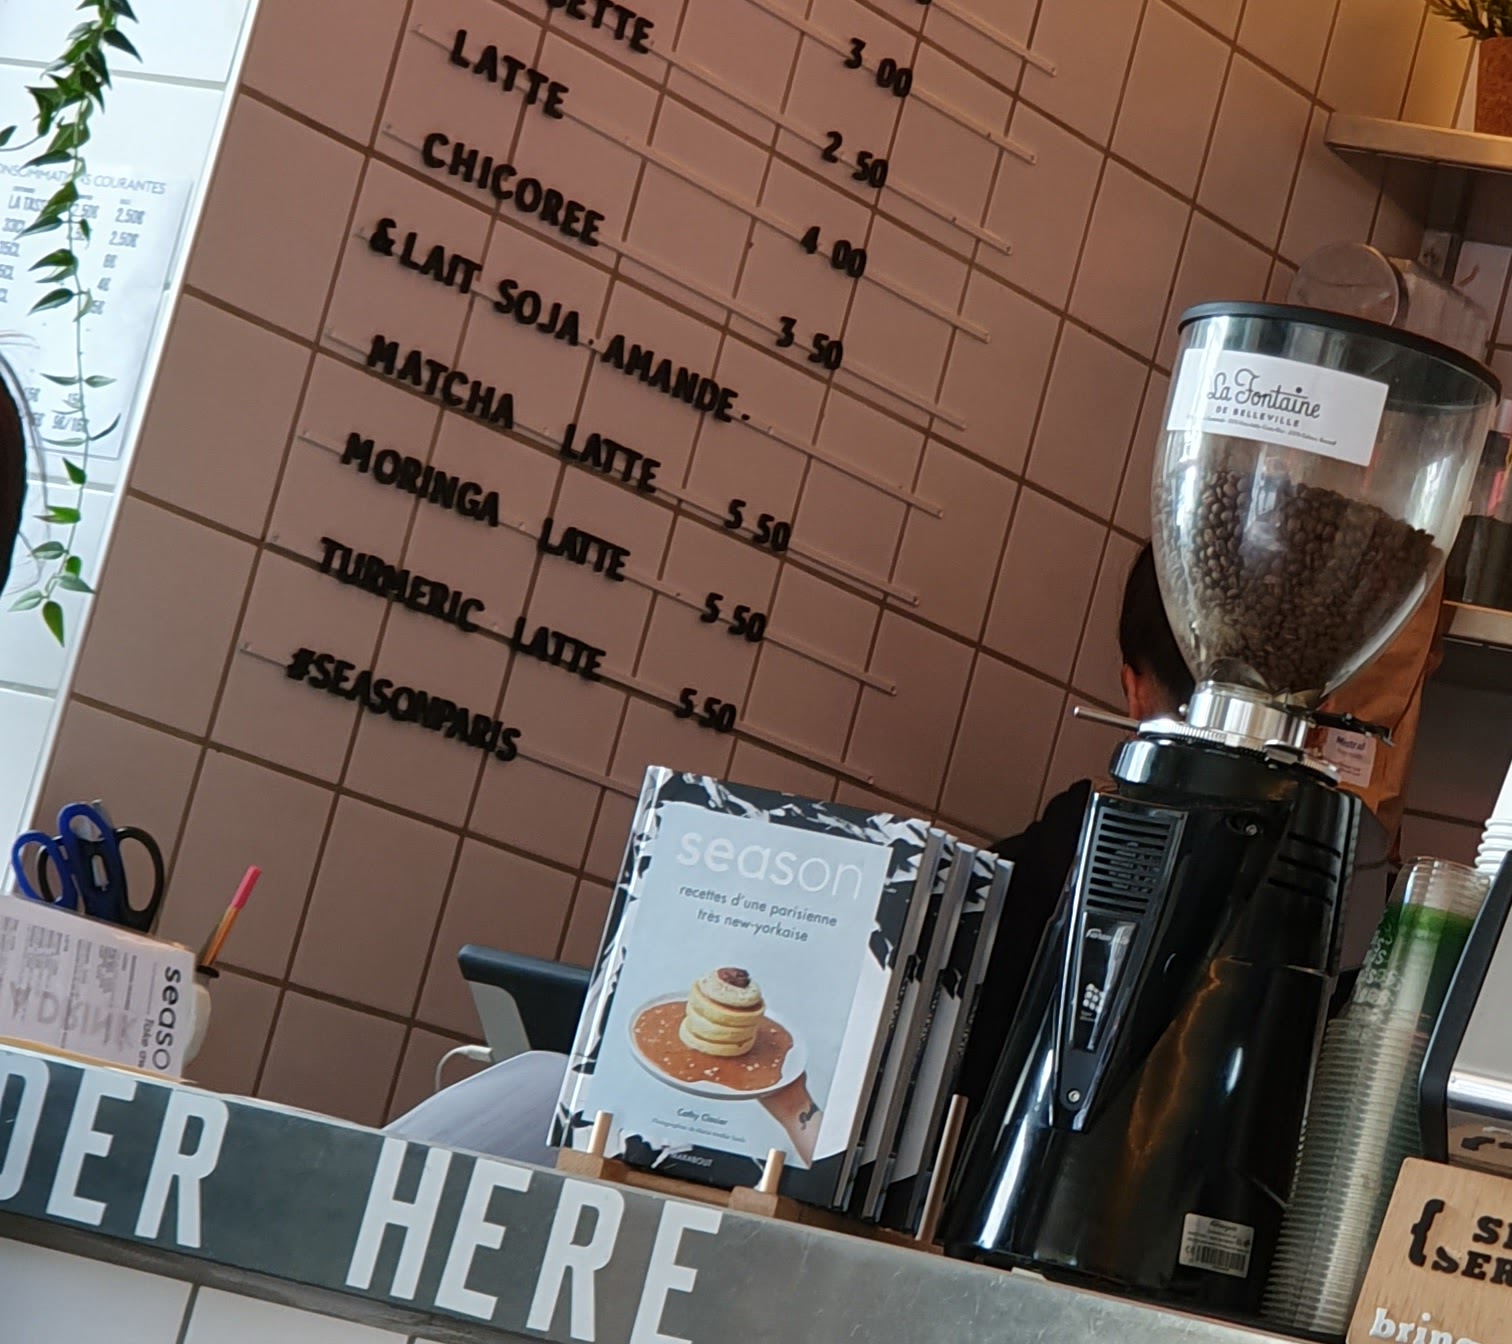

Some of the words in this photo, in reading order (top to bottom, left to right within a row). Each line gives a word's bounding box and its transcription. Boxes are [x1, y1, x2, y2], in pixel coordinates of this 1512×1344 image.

[450, 29, 569, 120] LATTE
[94, 175, 166, 195] COURANTES
[422, 133, 605, 247] CHICOREE
[367, 335, 514, 431] MATCHA
[559, 424, 661, 494] LATTE
[1207, 372, 1232, 401] La
[1235, 368, 1320, 419] Fontaine
[1233, 407, 1300, 427] BELLEVILLE
[341, 432, 500, 528] MORINGA
[539, 519, 630, 582] LATTE
[318, 538, 485, 634] TURMERIC
[512, 618, 606, 682] LATTE
[677, 832, 862, 900] season
[679, 885, 727, 904] recettes
[770, 904, 837, 927] parisienne
[724, 916, 808, 942] new-yorkaise
